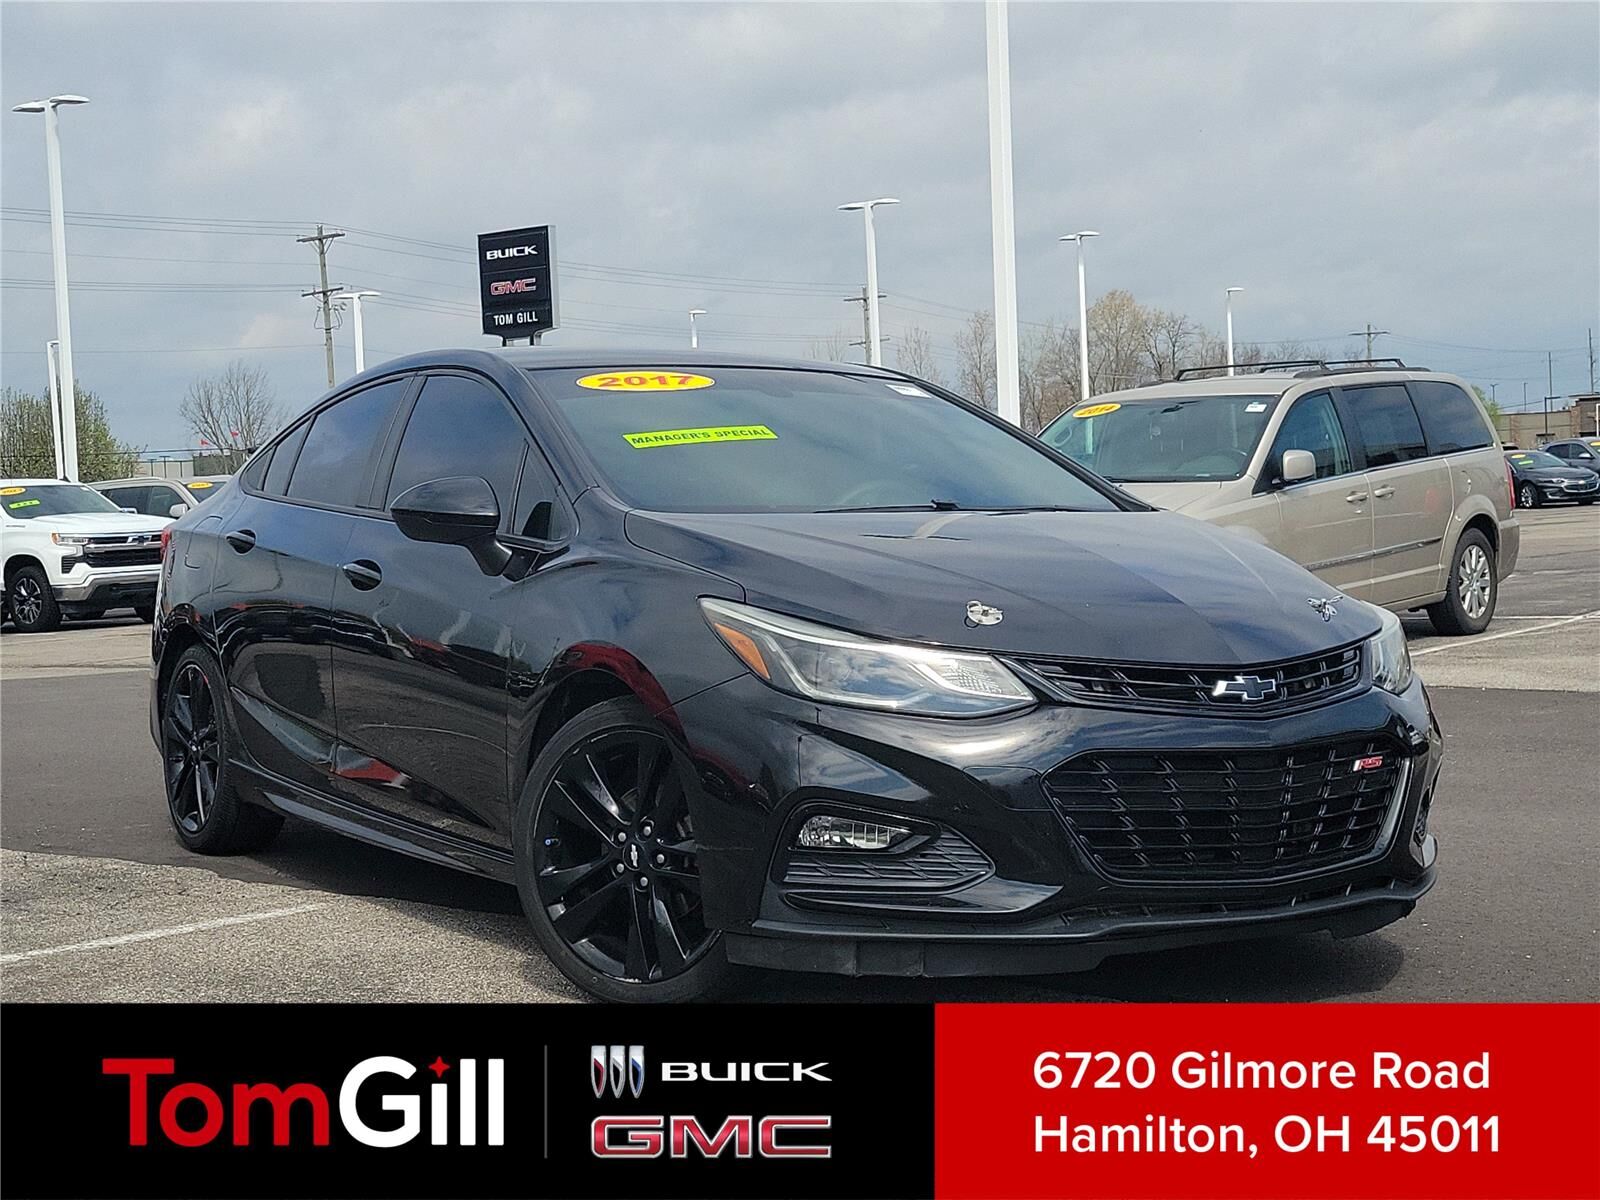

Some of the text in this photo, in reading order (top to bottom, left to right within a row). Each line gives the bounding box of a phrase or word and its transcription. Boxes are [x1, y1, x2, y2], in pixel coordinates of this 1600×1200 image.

[486, 245, 538, 260] BUICK
[490, 277, 537, 296] GMC
[493, 311, 538, 326] TOM GILL
[597, 375, 694, 387] 2017
[631, 428, 770, 444] MANAGER'S SPECIAL
